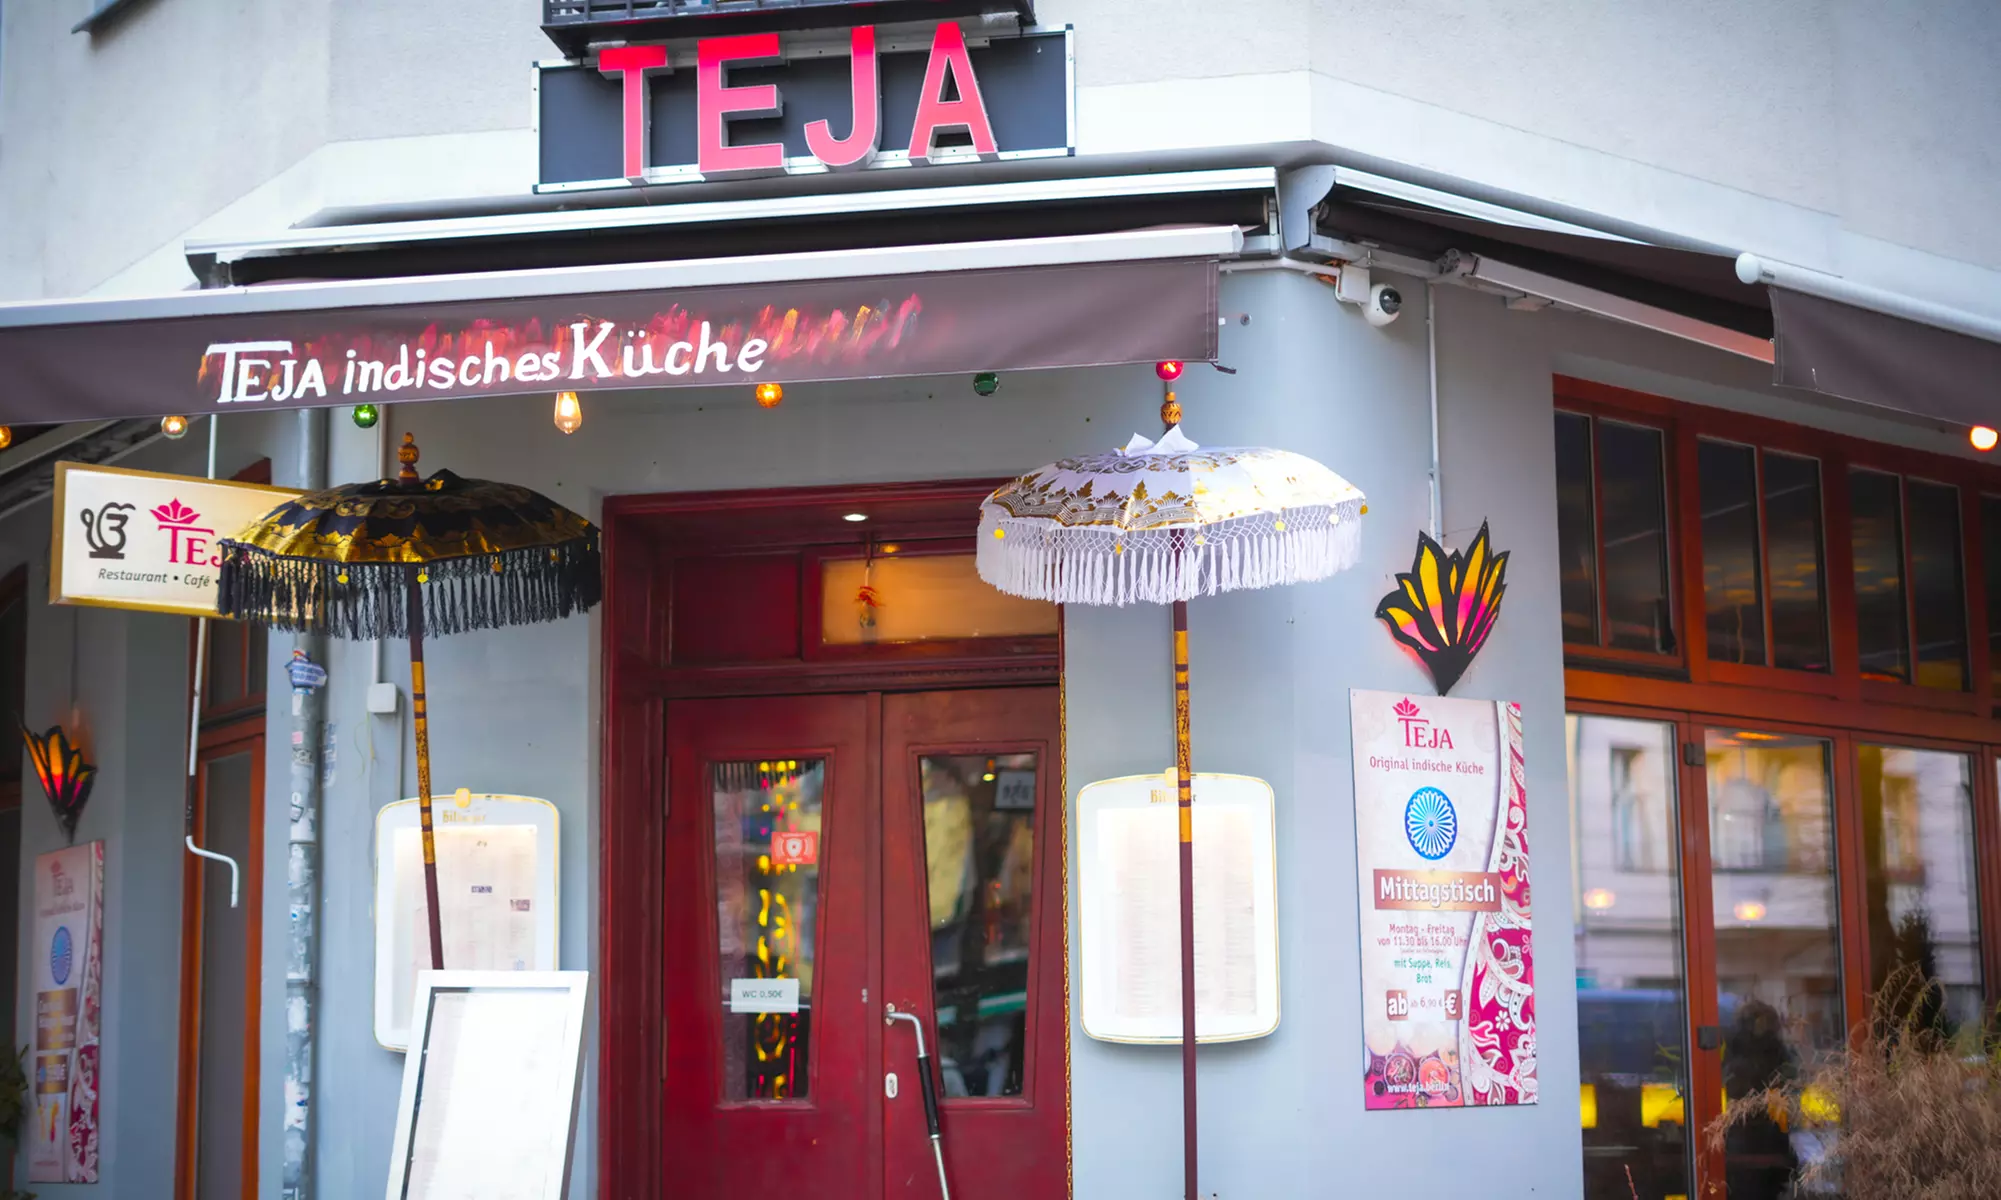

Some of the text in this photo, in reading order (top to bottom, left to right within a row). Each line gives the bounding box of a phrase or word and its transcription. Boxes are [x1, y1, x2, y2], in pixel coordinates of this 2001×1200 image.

[598, 21, 998, 181] TEJA
[205, 320, 769, 403] TEJA indisches Küche
[98, 568, 211, 588] Restaurant Café
[1397, 717, 1455, 750] TEJA
[1369, 756, 1485, 775] Original indische Küche
[1380, 876, 1495, 908] Mittagstisch
[1388, 924, 1419, 936] Montag
[1427, 924, 1455, 936] Freitag
[1377, 937, 1391, 946] von
[1393, 936, 1415, 946] 11.30
[1416, 936, 1429, 946] bis
[1431, 936, 1452, 946] 16.00
[1394, 958, 1407, 968] mit
[1415, 973, 1433, 984] Brot
[742, 990, 758, 998] WC
[1387, 992, 1409, 1016] ab
